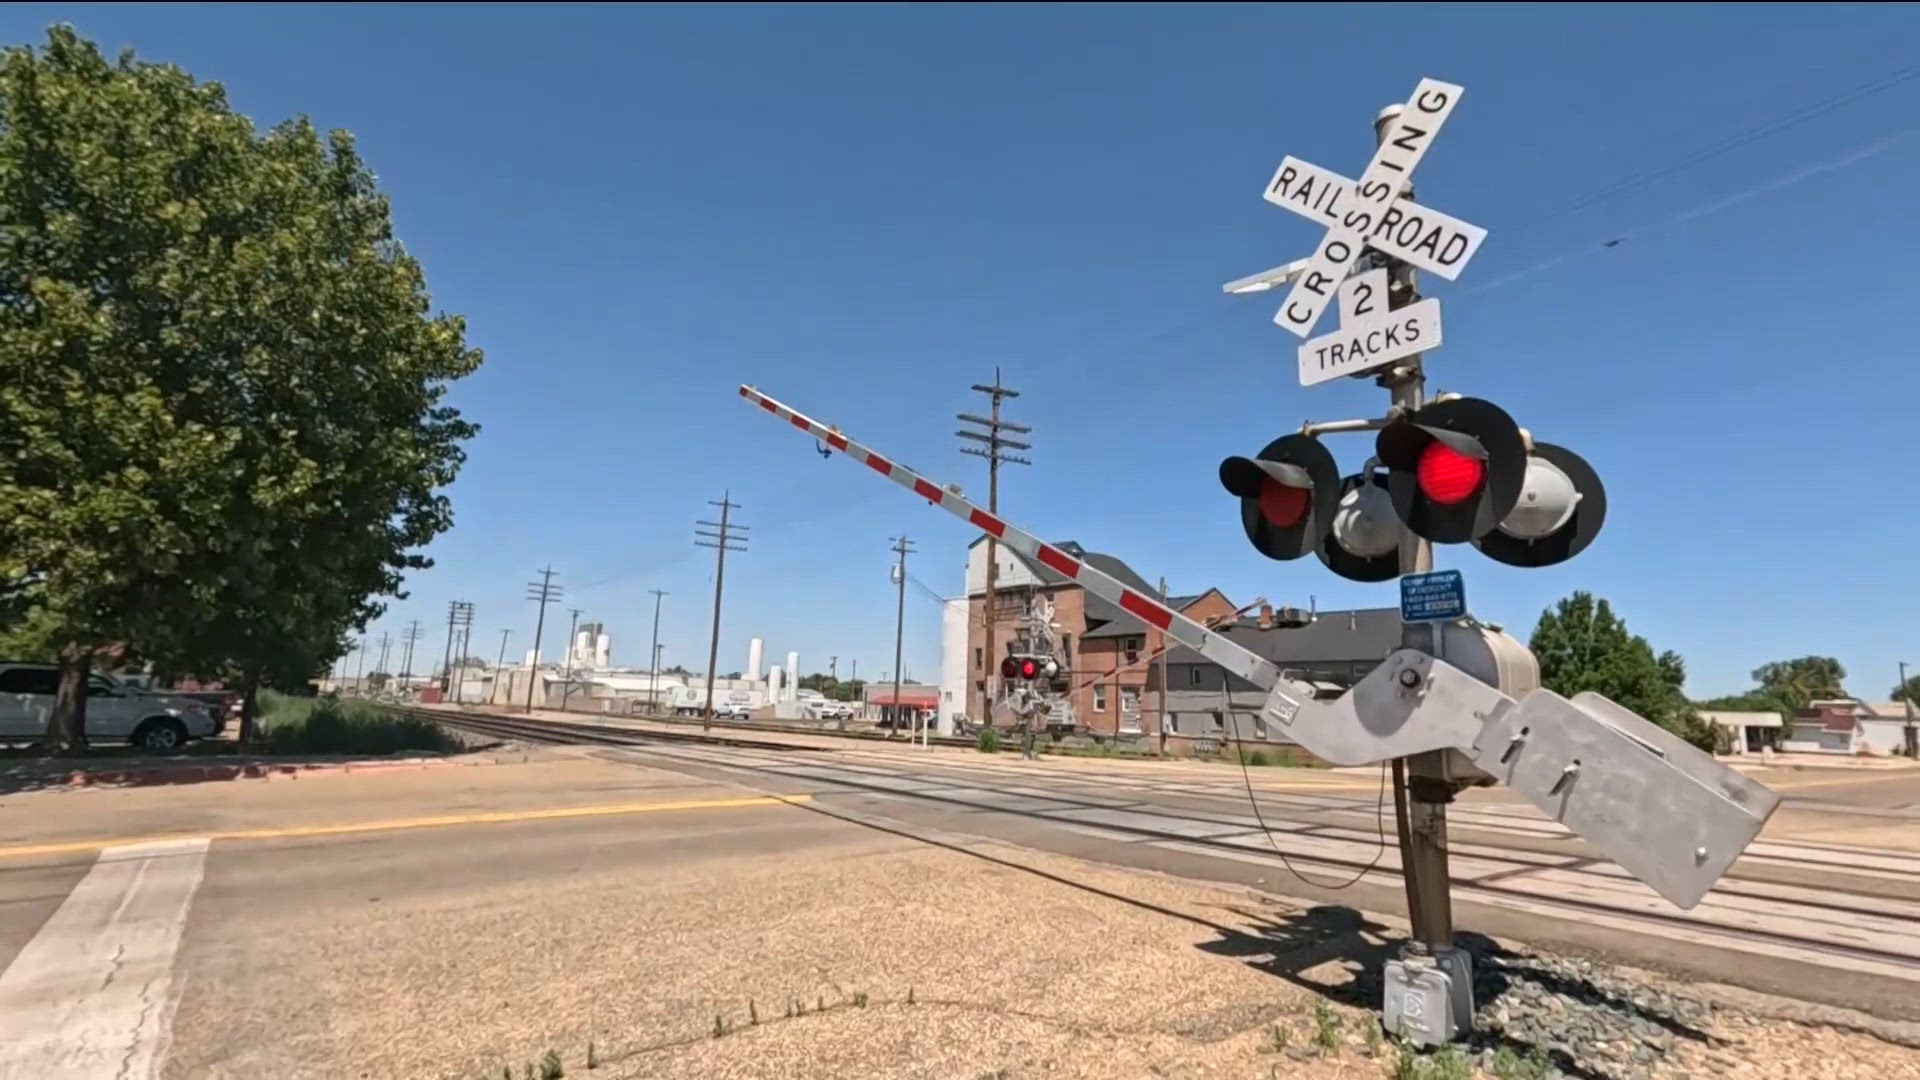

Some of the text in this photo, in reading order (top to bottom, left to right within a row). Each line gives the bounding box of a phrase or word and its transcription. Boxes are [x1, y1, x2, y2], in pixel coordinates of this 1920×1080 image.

[1286, 89, 1448, 324] CROSSING
[1353, 281, 1374, 316] 2
[1315, 319, 1420, 370] TRACKS
